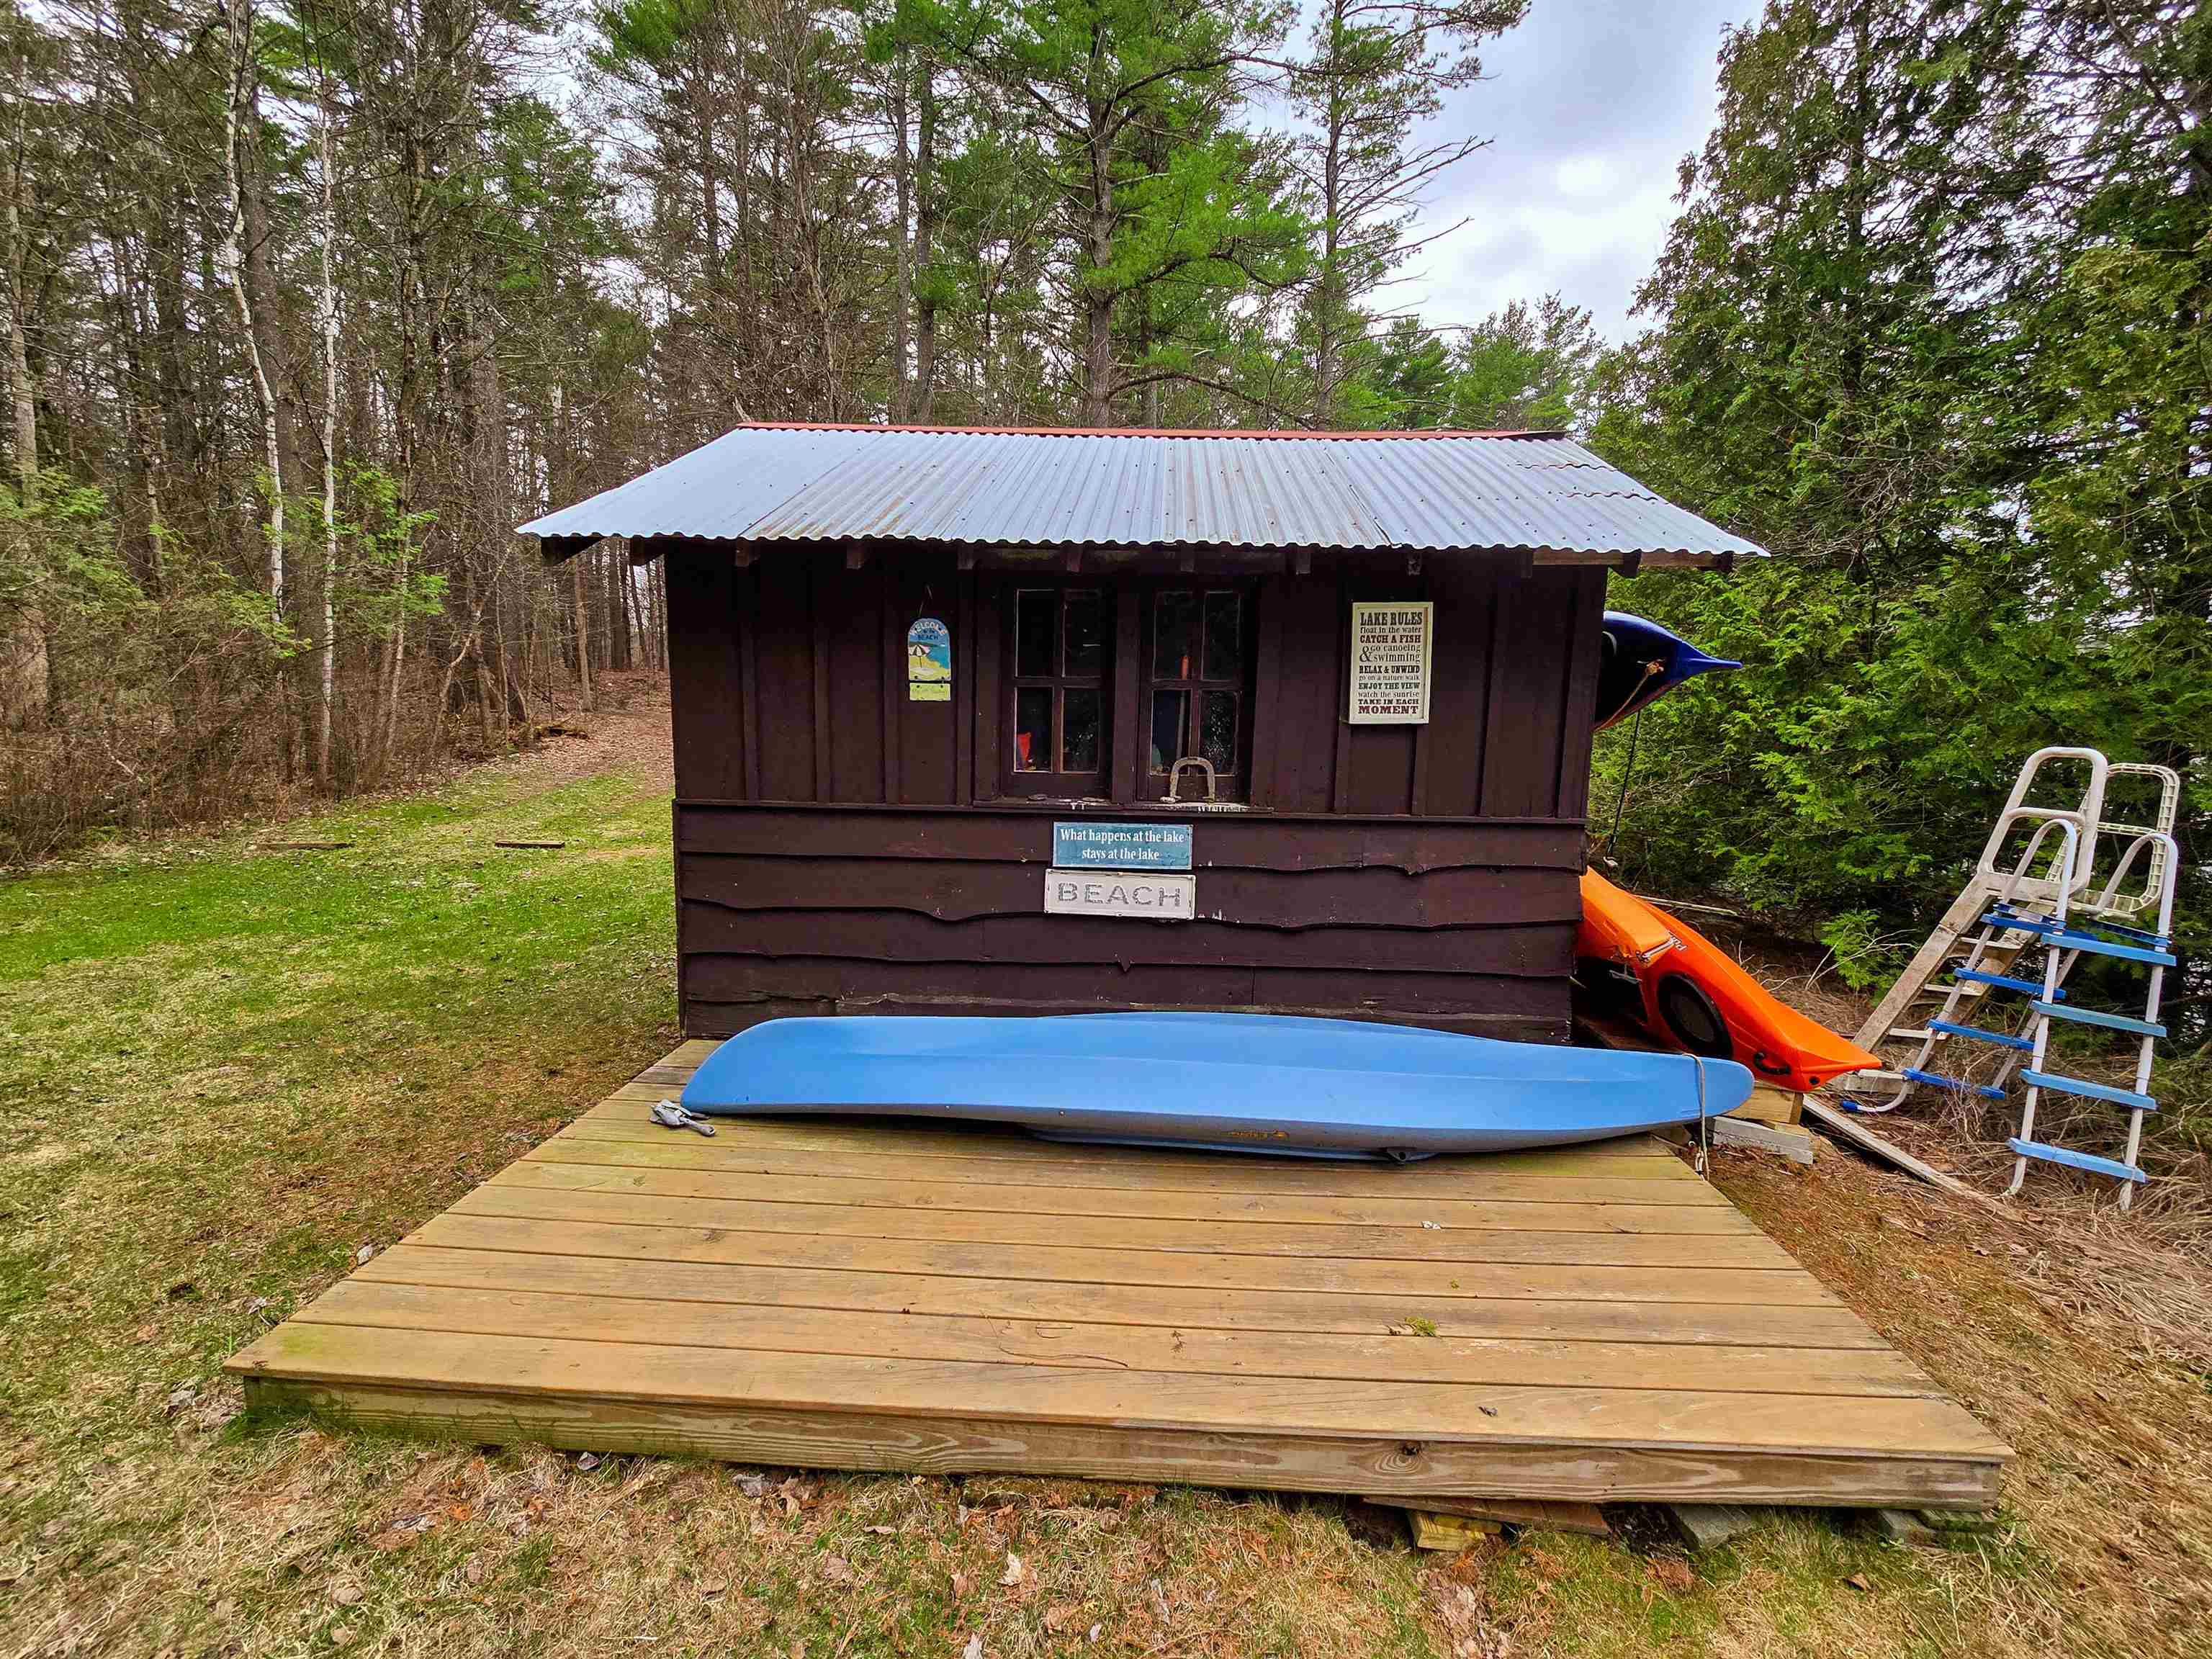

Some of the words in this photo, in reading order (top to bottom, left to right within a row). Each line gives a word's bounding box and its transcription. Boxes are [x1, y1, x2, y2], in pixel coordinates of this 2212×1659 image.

[1359, 612, 1388, 626] LAKE
[1390, 611, 1423, 626] RULES
[1359, 634, 1389, 643] CATCH
[1391, 634, 1397, 643] A
[1399, 634, 1421, 643] FISH
[1359, 645, 1373, 662] &
[1373, 652, 1421, 662] swimming
[1359, 665, 1382, 674] RELAX
[1383, 665, 1390, 674] &
[1390, 665, 1420, 674] UNWIND
[1358, 706, 1419, 714] MOMENT
[1060, 828, 1087, 842] What
[1089, 830, 1131, 844] happens
[1133, 831, 1144, 842] at
[1145, 830, 1161, 842] the
[1163, 831, 1184, 842] lake
[1082, 848, 1105, 860] stays
[1107, 849, 1118, 859] at
[1120, 848, 1136, 860] the
[1138, 848, 1160, 860] lake
[1058, 882, 1182, 907] BEACH
